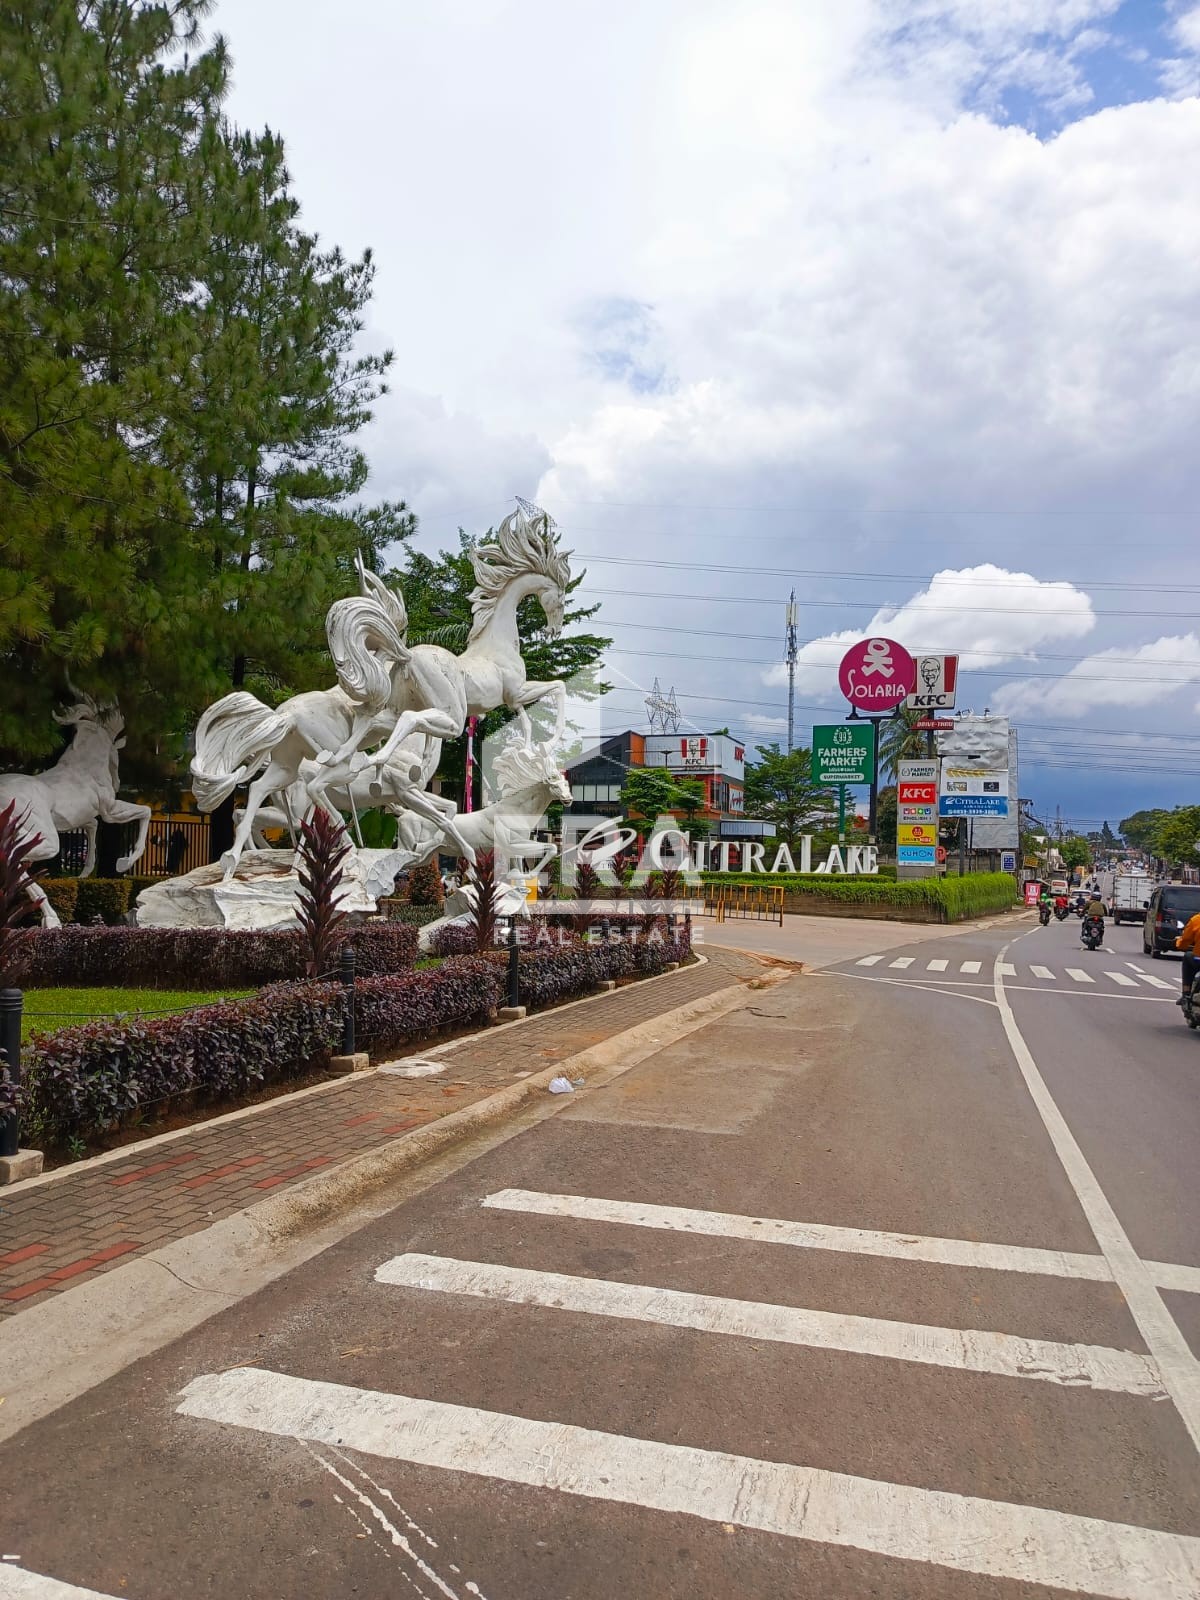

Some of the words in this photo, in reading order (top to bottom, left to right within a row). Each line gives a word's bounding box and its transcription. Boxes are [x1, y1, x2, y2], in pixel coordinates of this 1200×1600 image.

[847, 668, 906, 698] SOLARIA
[913, 695, 946, 706] KFC
[817, 747, 867, 758] FARMERS
[820, 756, 865, 767] MARKET
[902, 788, 932, 799] KFC
